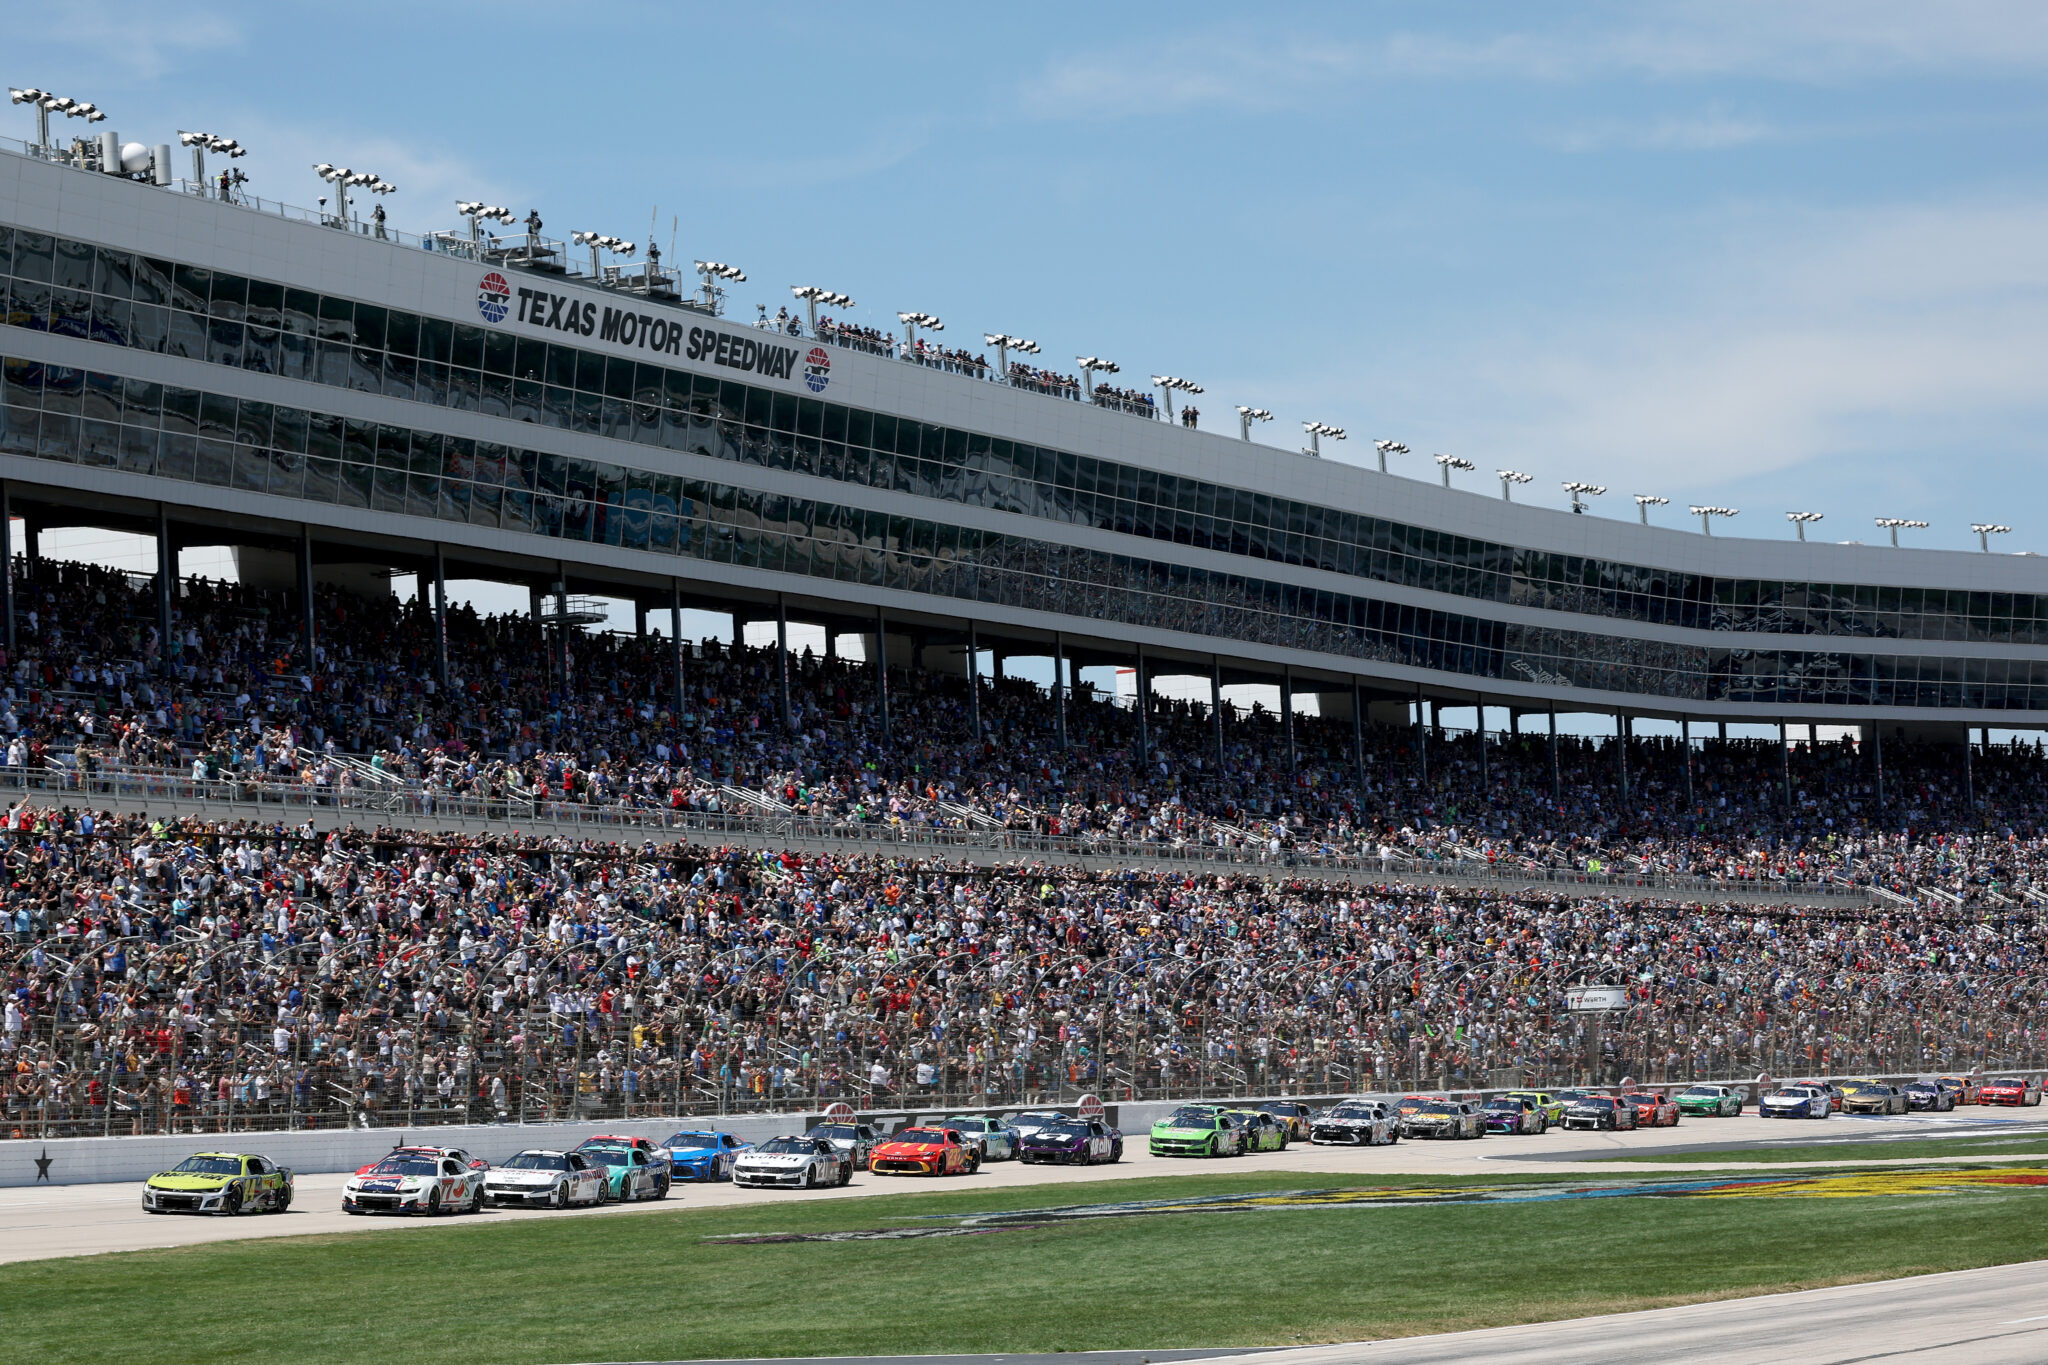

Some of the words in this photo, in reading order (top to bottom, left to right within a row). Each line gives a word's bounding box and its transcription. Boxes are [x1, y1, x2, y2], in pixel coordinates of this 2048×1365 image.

[517, 286, 597, 337] TEXAS
[600, 307, 683, 355] MOTOR
[687, 326, 800, 380] SPEEDWAY
[441, 1178, 454, 1200] 77
[570, 1174, 580, 1197] 2
